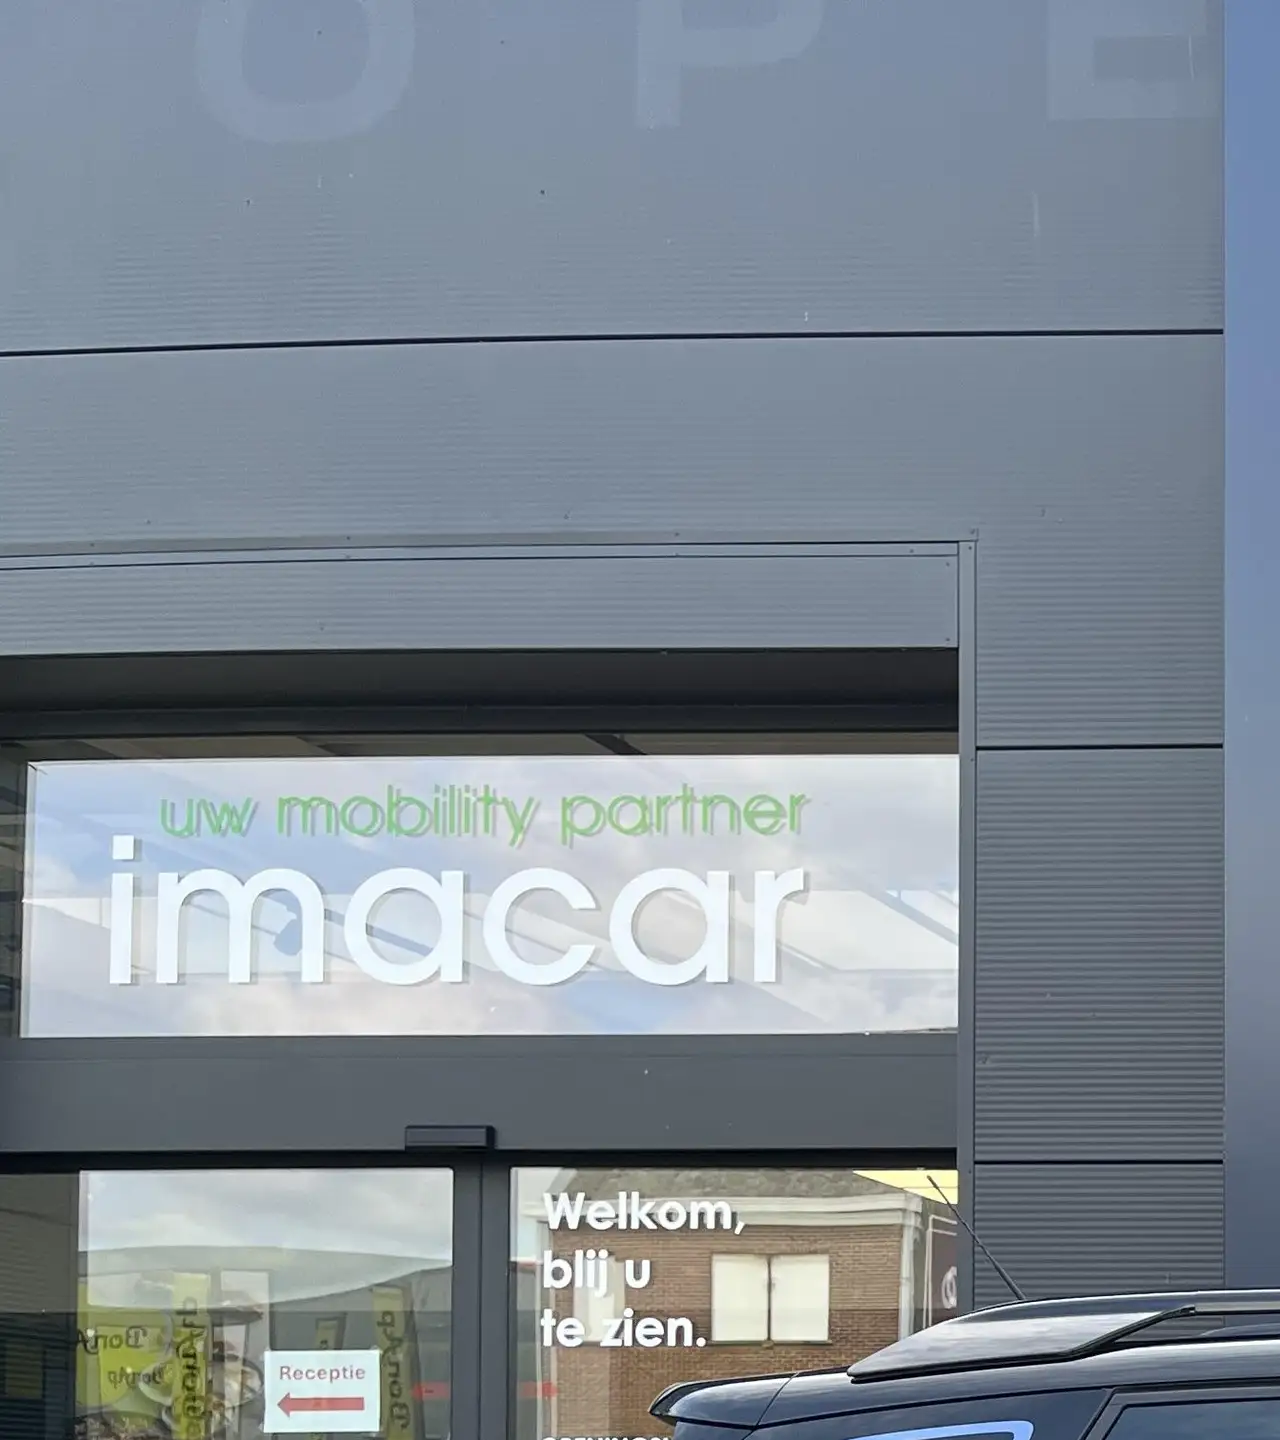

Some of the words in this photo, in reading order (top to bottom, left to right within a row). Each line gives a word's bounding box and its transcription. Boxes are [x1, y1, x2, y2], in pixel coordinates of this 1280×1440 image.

[160, 797, 257, 838] uw
[277, 784, 540, 847] mobility
[561, 784, 807, 847] partner
[109, 834, 804, 986] imacar
[543, 1191, 746, 1236] Welkom,
[543, 1249, 609, 1298] blij
[625, 1259, 651, 1289] u
[541, 1308, 584, 1347] te
[602, 1308, 707, 1347] zien.
[279, 1364, 366, 1385] Receptie
